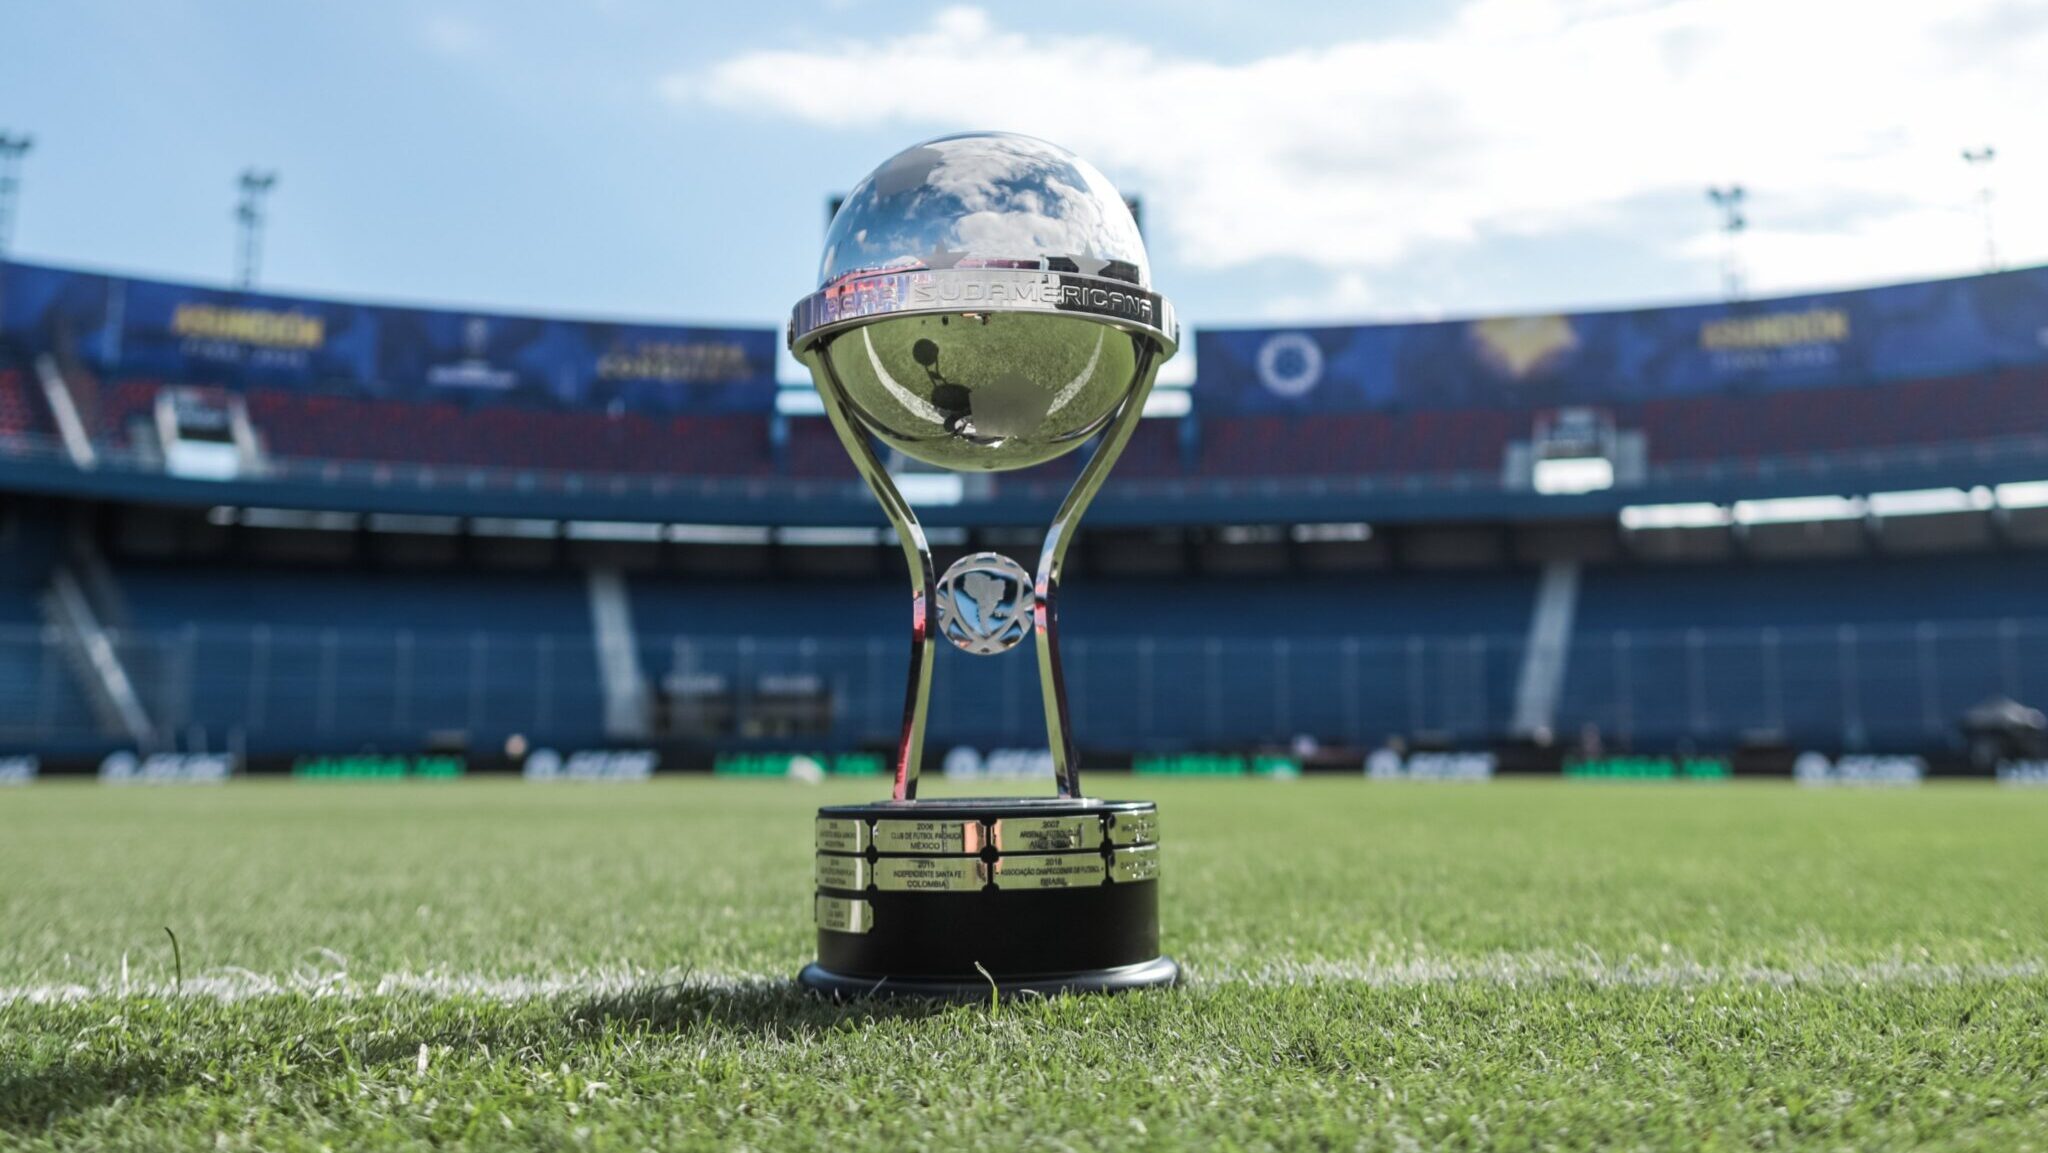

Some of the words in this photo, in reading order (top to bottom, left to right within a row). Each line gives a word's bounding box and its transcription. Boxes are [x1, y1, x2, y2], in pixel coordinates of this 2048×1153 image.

[913, 279, 1153, 319] SUDAMERICANA
[1042, 820, 1060, 828] 2007
[910, 841, 941, 850] MÉXICO
[893, 870, 934, 878] INDEPENDIENTE
[935, 870, 953, 878] SANTA
[953, 870, 962, 878] FE
[906, 880, 947, 888] COLOMBIA
